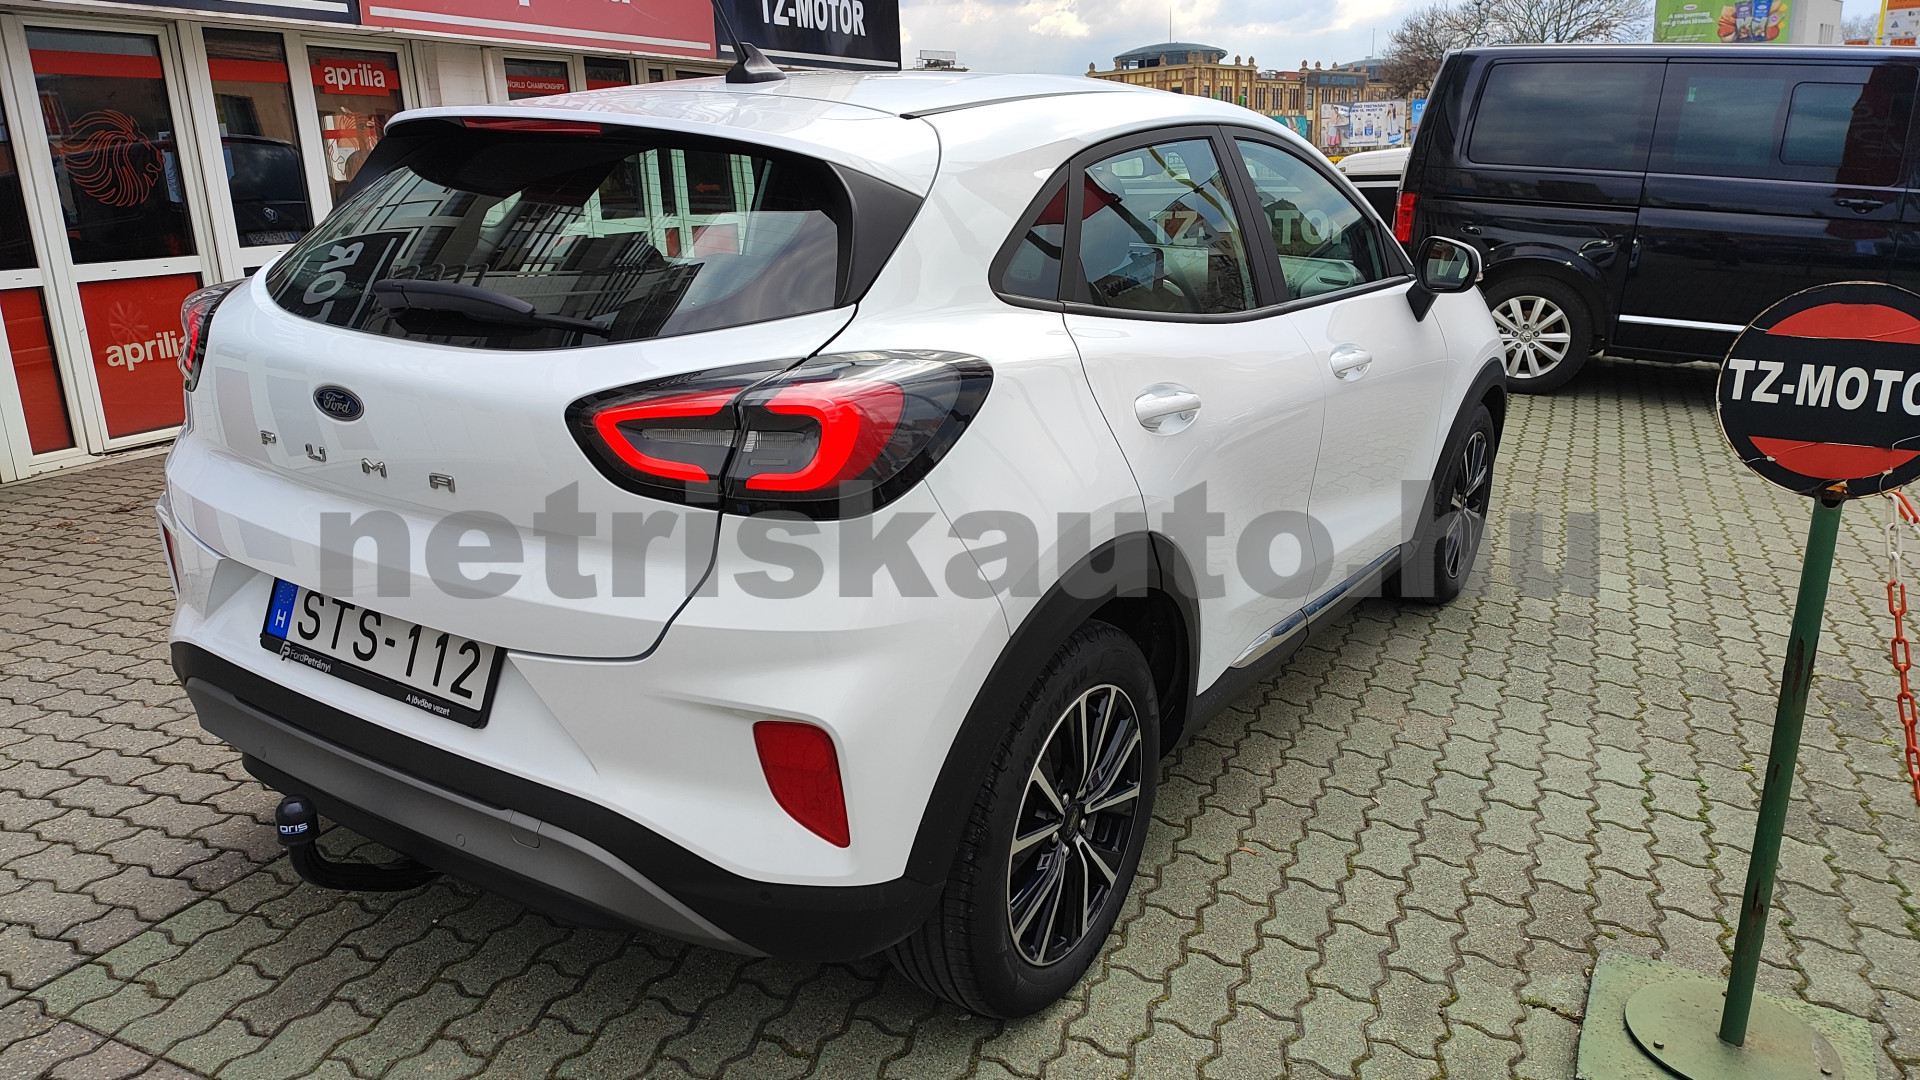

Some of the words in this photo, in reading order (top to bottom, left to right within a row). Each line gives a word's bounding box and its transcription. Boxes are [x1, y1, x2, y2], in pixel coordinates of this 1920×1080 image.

[324, 63, 386, 91] aprilia
[323, 391, 351, 414] Ford
[260, 430, 456, 493] PUMA
[275, 609, 287, 629] H
[297, 590, 481, 700] STS-112
